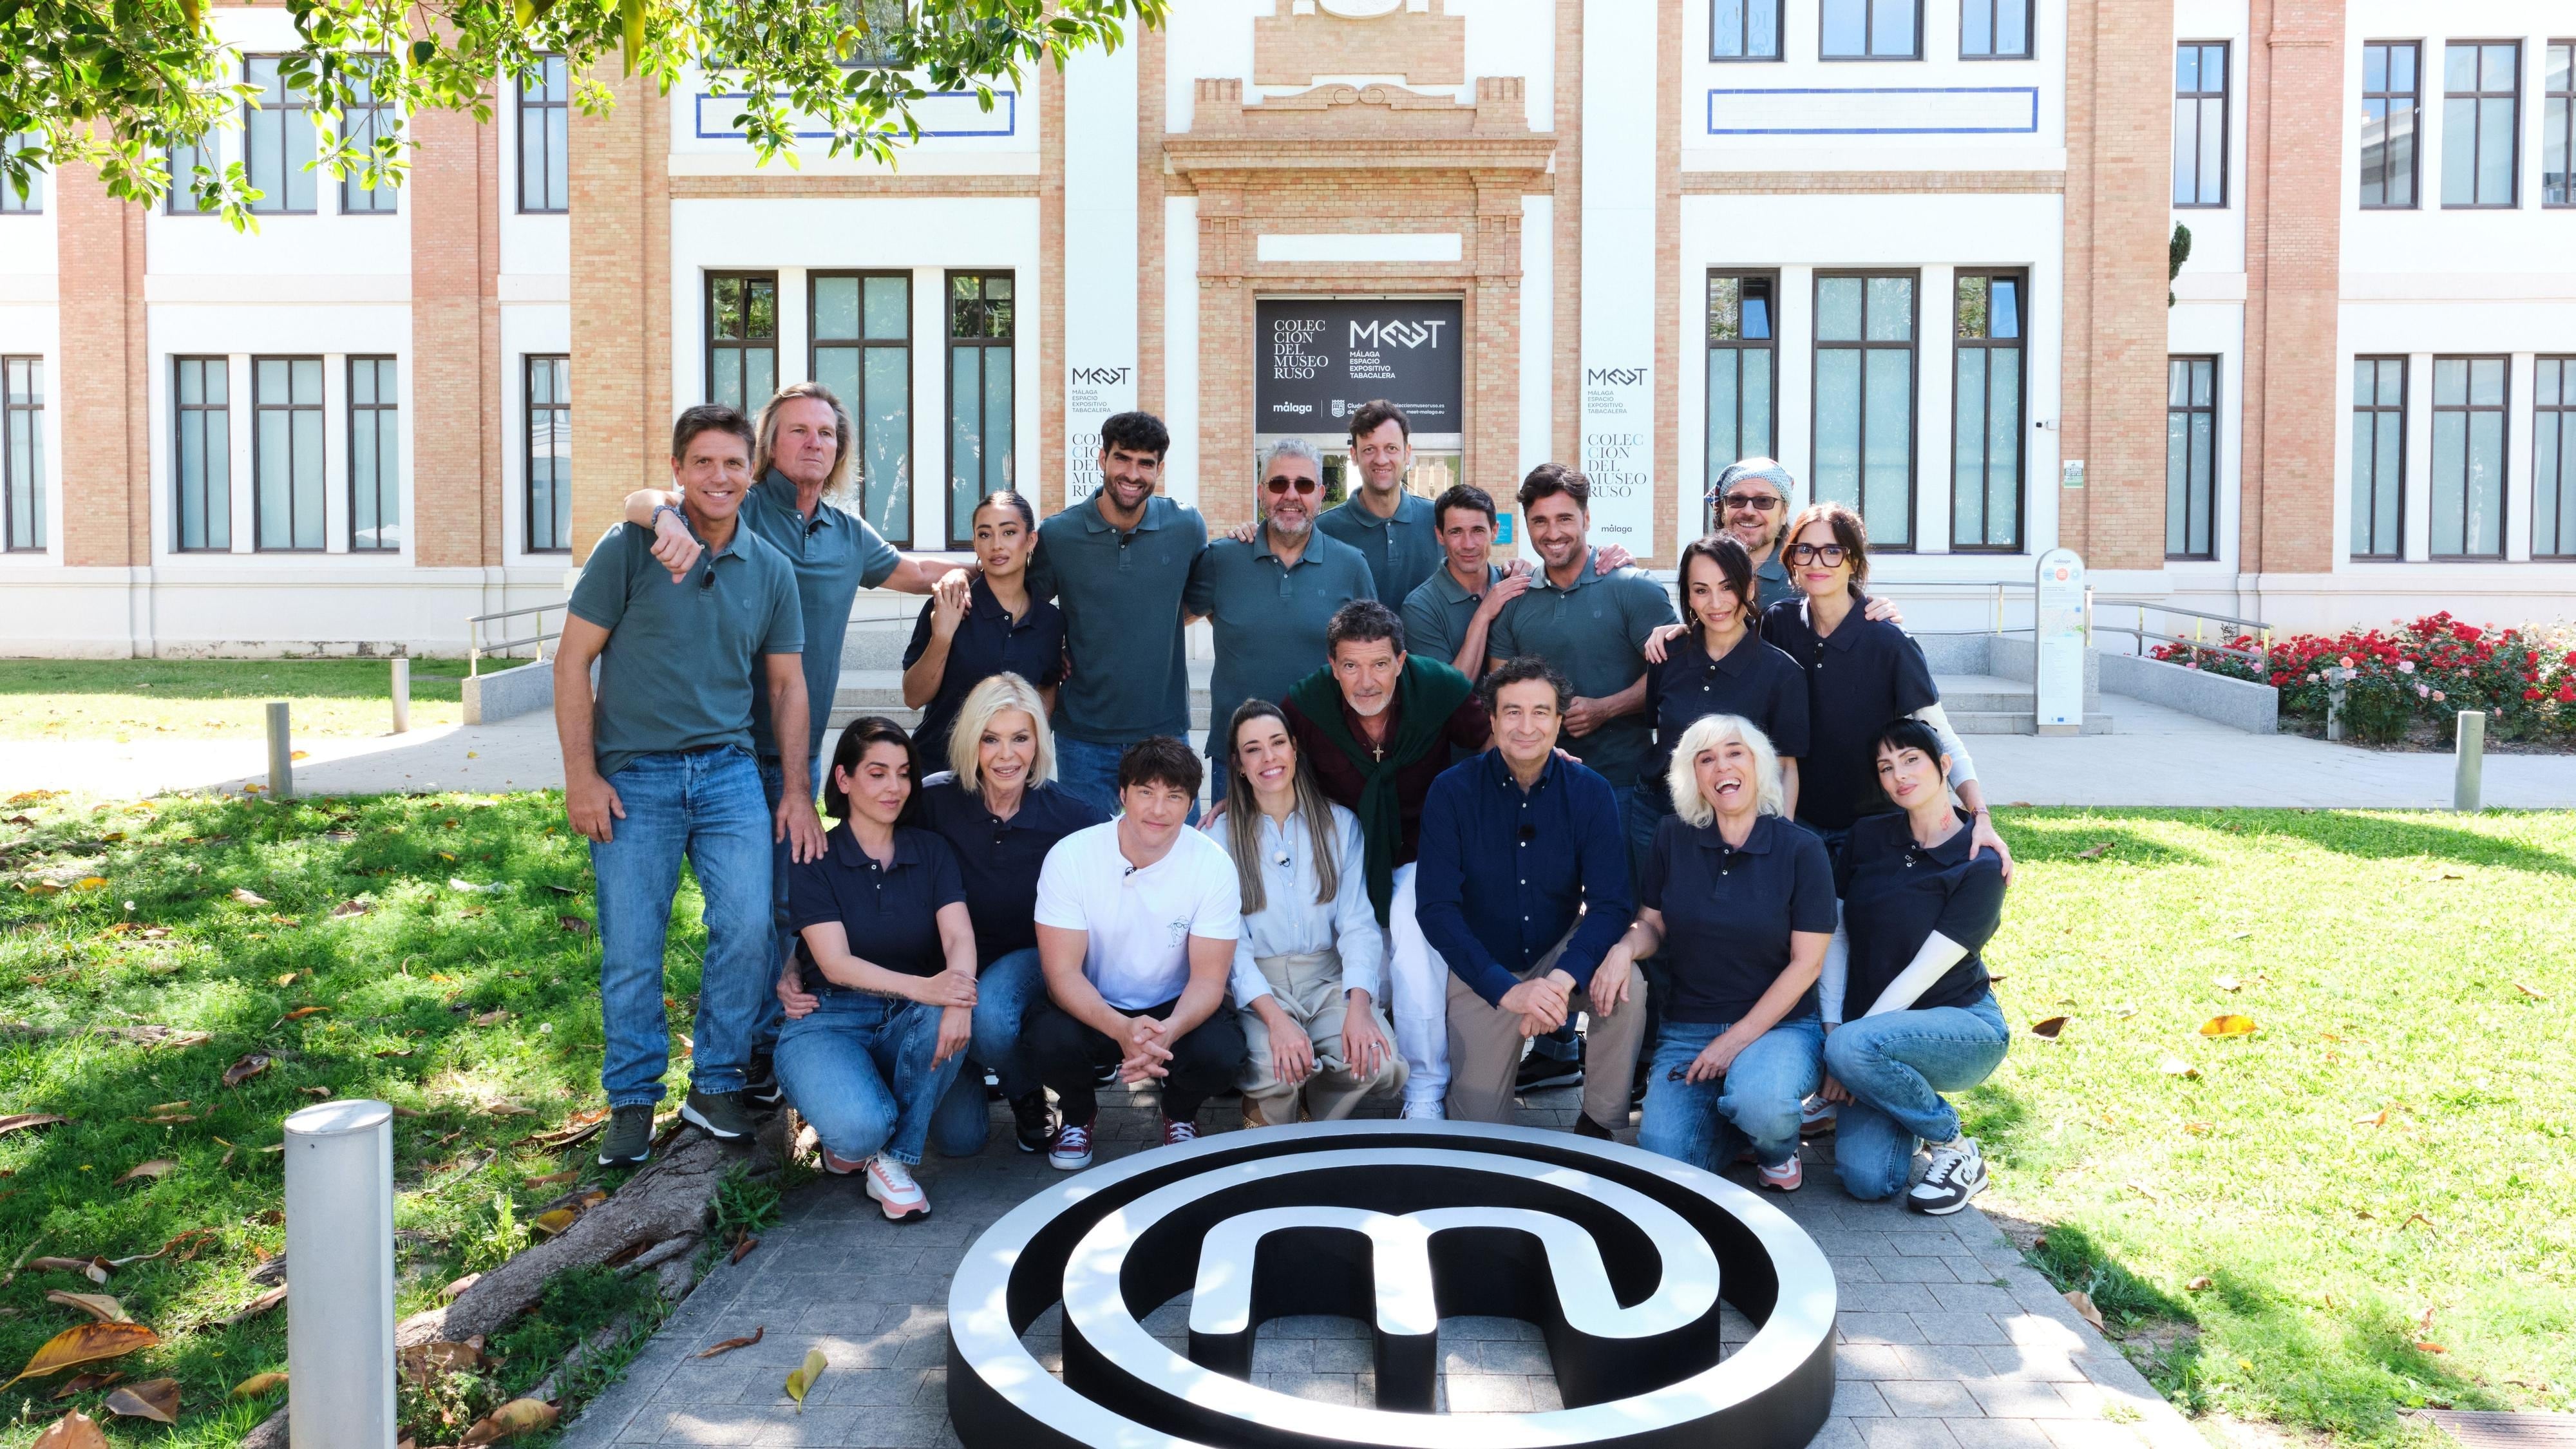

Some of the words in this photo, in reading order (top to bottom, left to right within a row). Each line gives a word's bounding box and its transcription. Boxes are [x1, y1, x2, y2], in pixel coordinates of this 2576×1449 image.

[1274, 319, 1325, 332] COLEC
[1274, 329, 1313, 343] CIÓN
[1274, 344, 1303, 355] DEL
[1274, 355, 1328, 367] MUSEO
[1274, 368, 1314, 379] RUSO
[1072, 433, 1103, 445] COL
[1588, 434, 1643, 446] COLEC
[1072, 445, 1101, 458] CIÓ
[1588, 446, 1629, 458] CIÓN
[1588, 460, 1620, 471] DEL
[1588, 473, 1646, 484] MUSEO
[1589, 486, 1631, 497] RUSO
